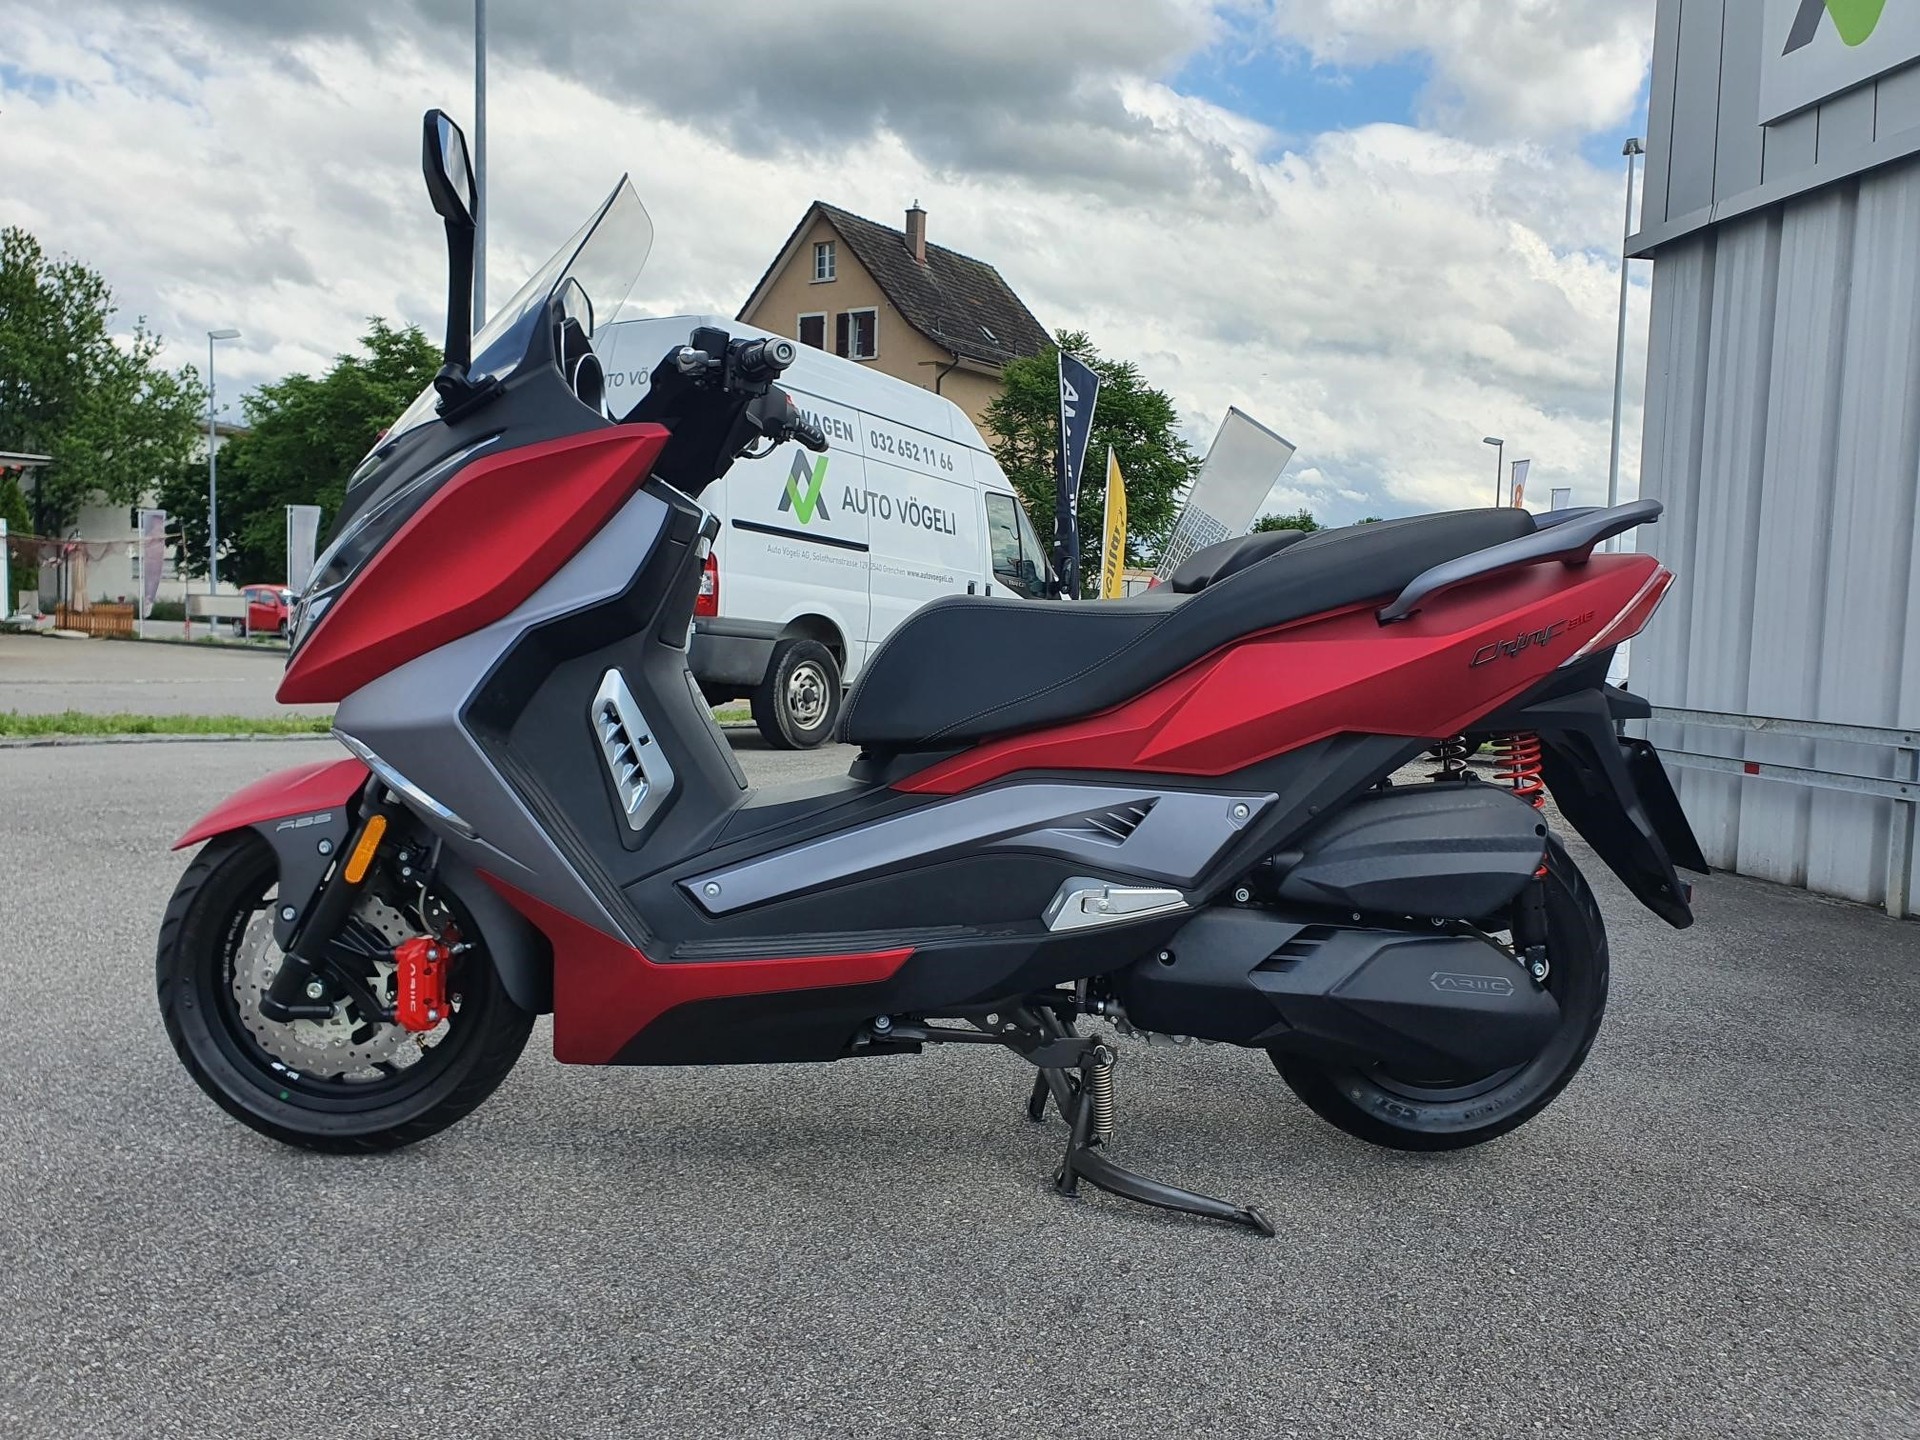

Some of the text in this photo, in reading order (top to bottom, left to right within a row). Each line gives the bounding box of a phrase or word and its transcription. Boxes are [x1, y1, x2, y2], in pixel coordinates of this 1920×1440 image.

[604, 372, 625, 388] TO
[870, 430, 895, 454] 032
[898, 438, 920, 461] 652
[922, 446, 936, 467] 11
[940, 452, 953, 472] 66
[841, 485, 956, 536] AUTO VÖGELI
[767, 544, 781, 554] Auto
[1441, 977, 1506, 991] ARIIC
